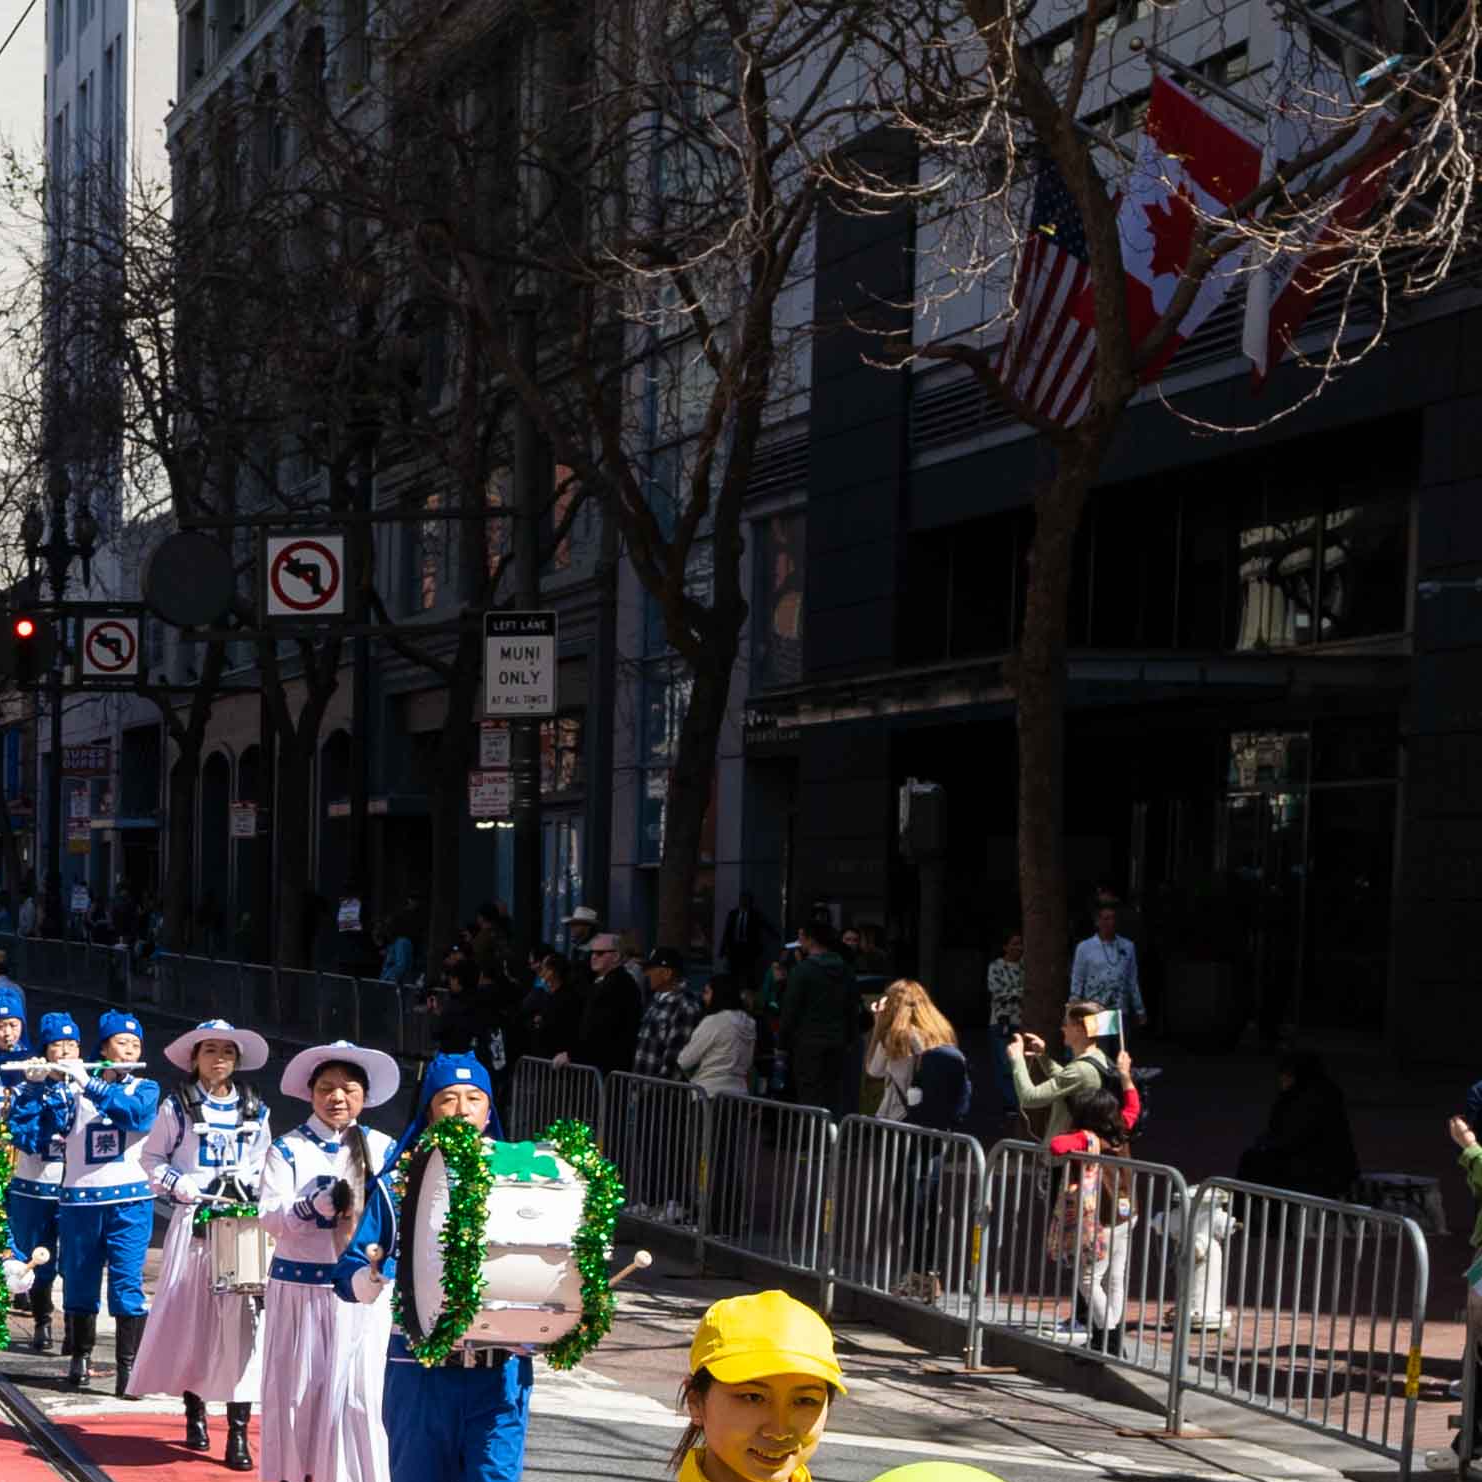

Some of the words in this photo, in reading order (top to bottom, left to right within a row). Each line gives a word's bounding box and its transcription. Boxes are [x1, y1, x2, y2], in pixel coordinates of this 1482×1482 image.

[492, 620, 516, 632] LEFT
[520, 619, 548, 632] LANE
[500, 645, 540, 660] MUNI
[498, 671, 540, 685] ONLY
